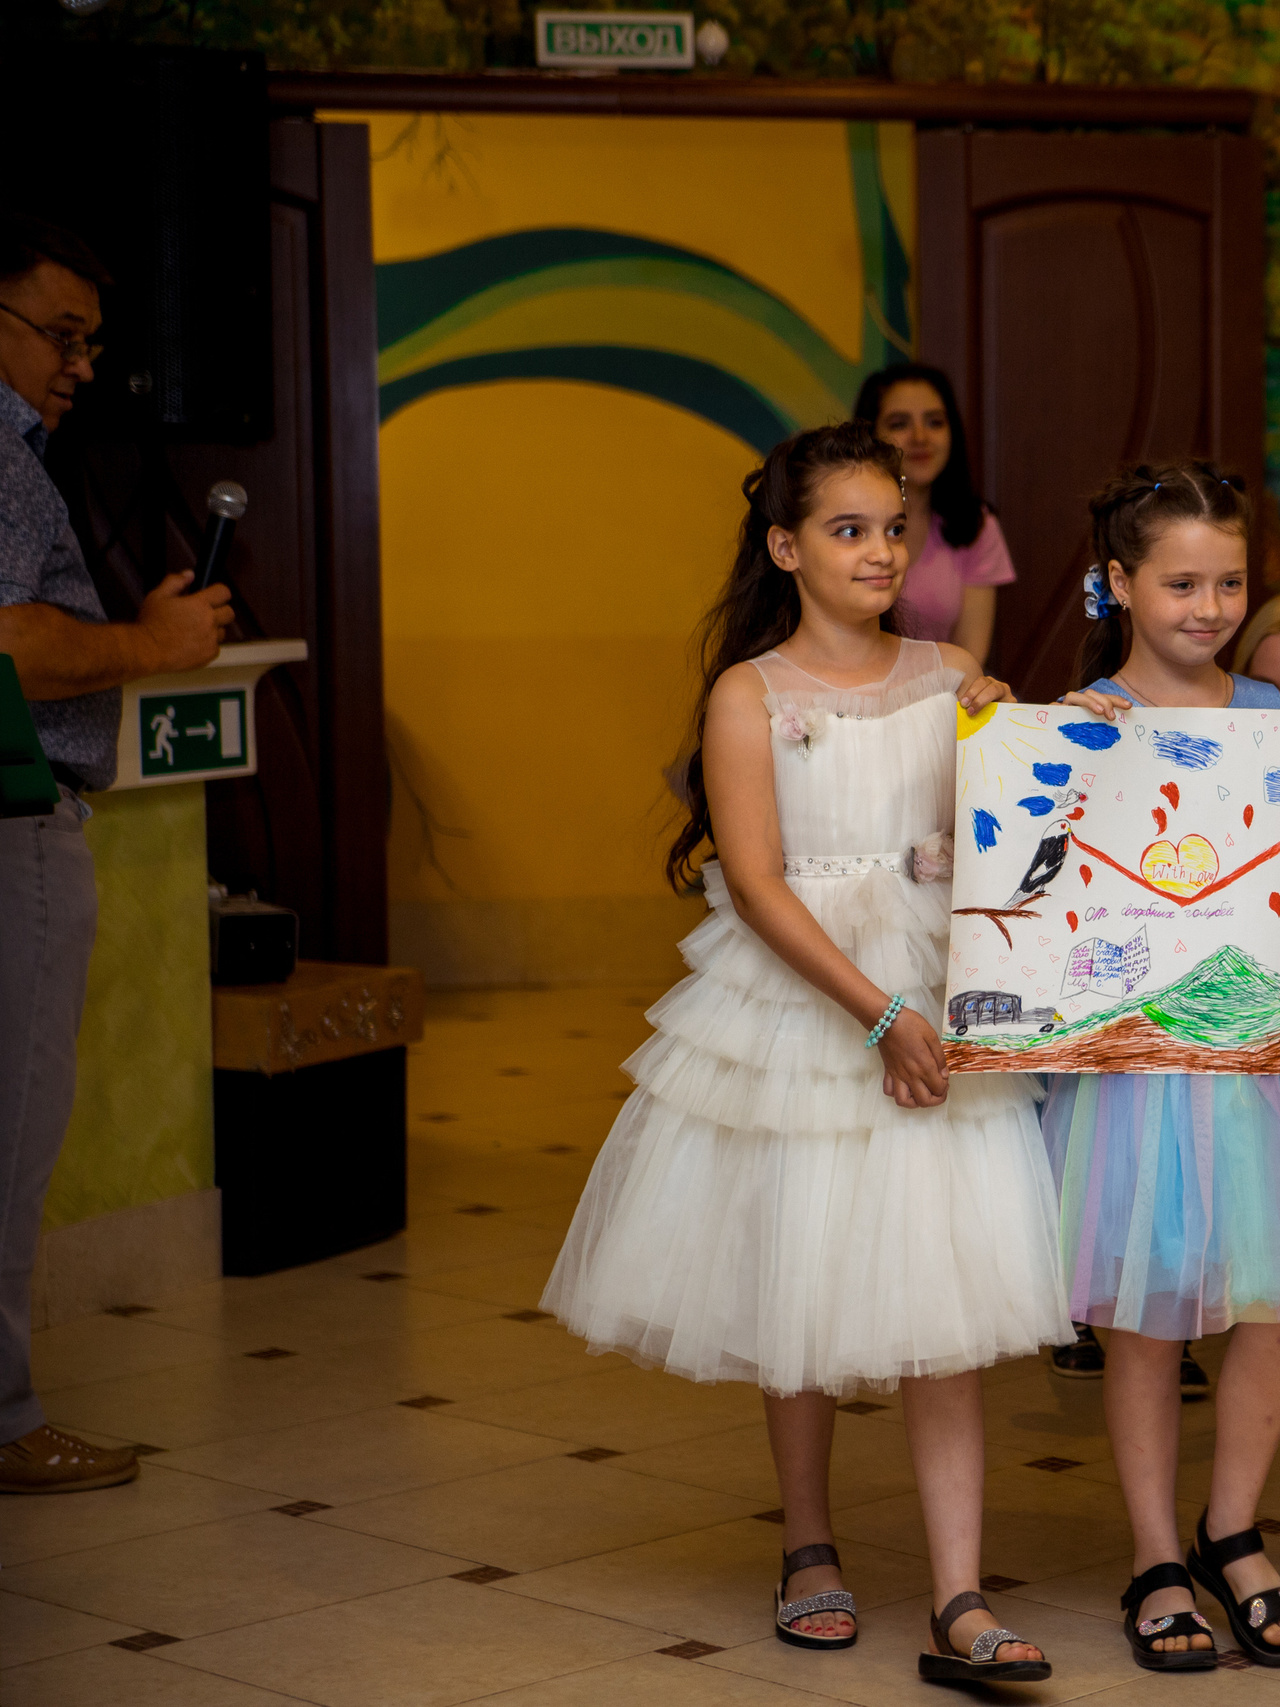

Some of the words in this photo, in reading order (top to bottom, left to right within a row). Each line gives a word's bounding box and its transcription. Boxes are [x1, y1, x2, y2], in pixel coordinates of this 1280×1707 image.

[552, 24, 680, 55] ВЫХОД
[1151, 862, 1186, 879] With
[1084, 906, 1109, 922] От
